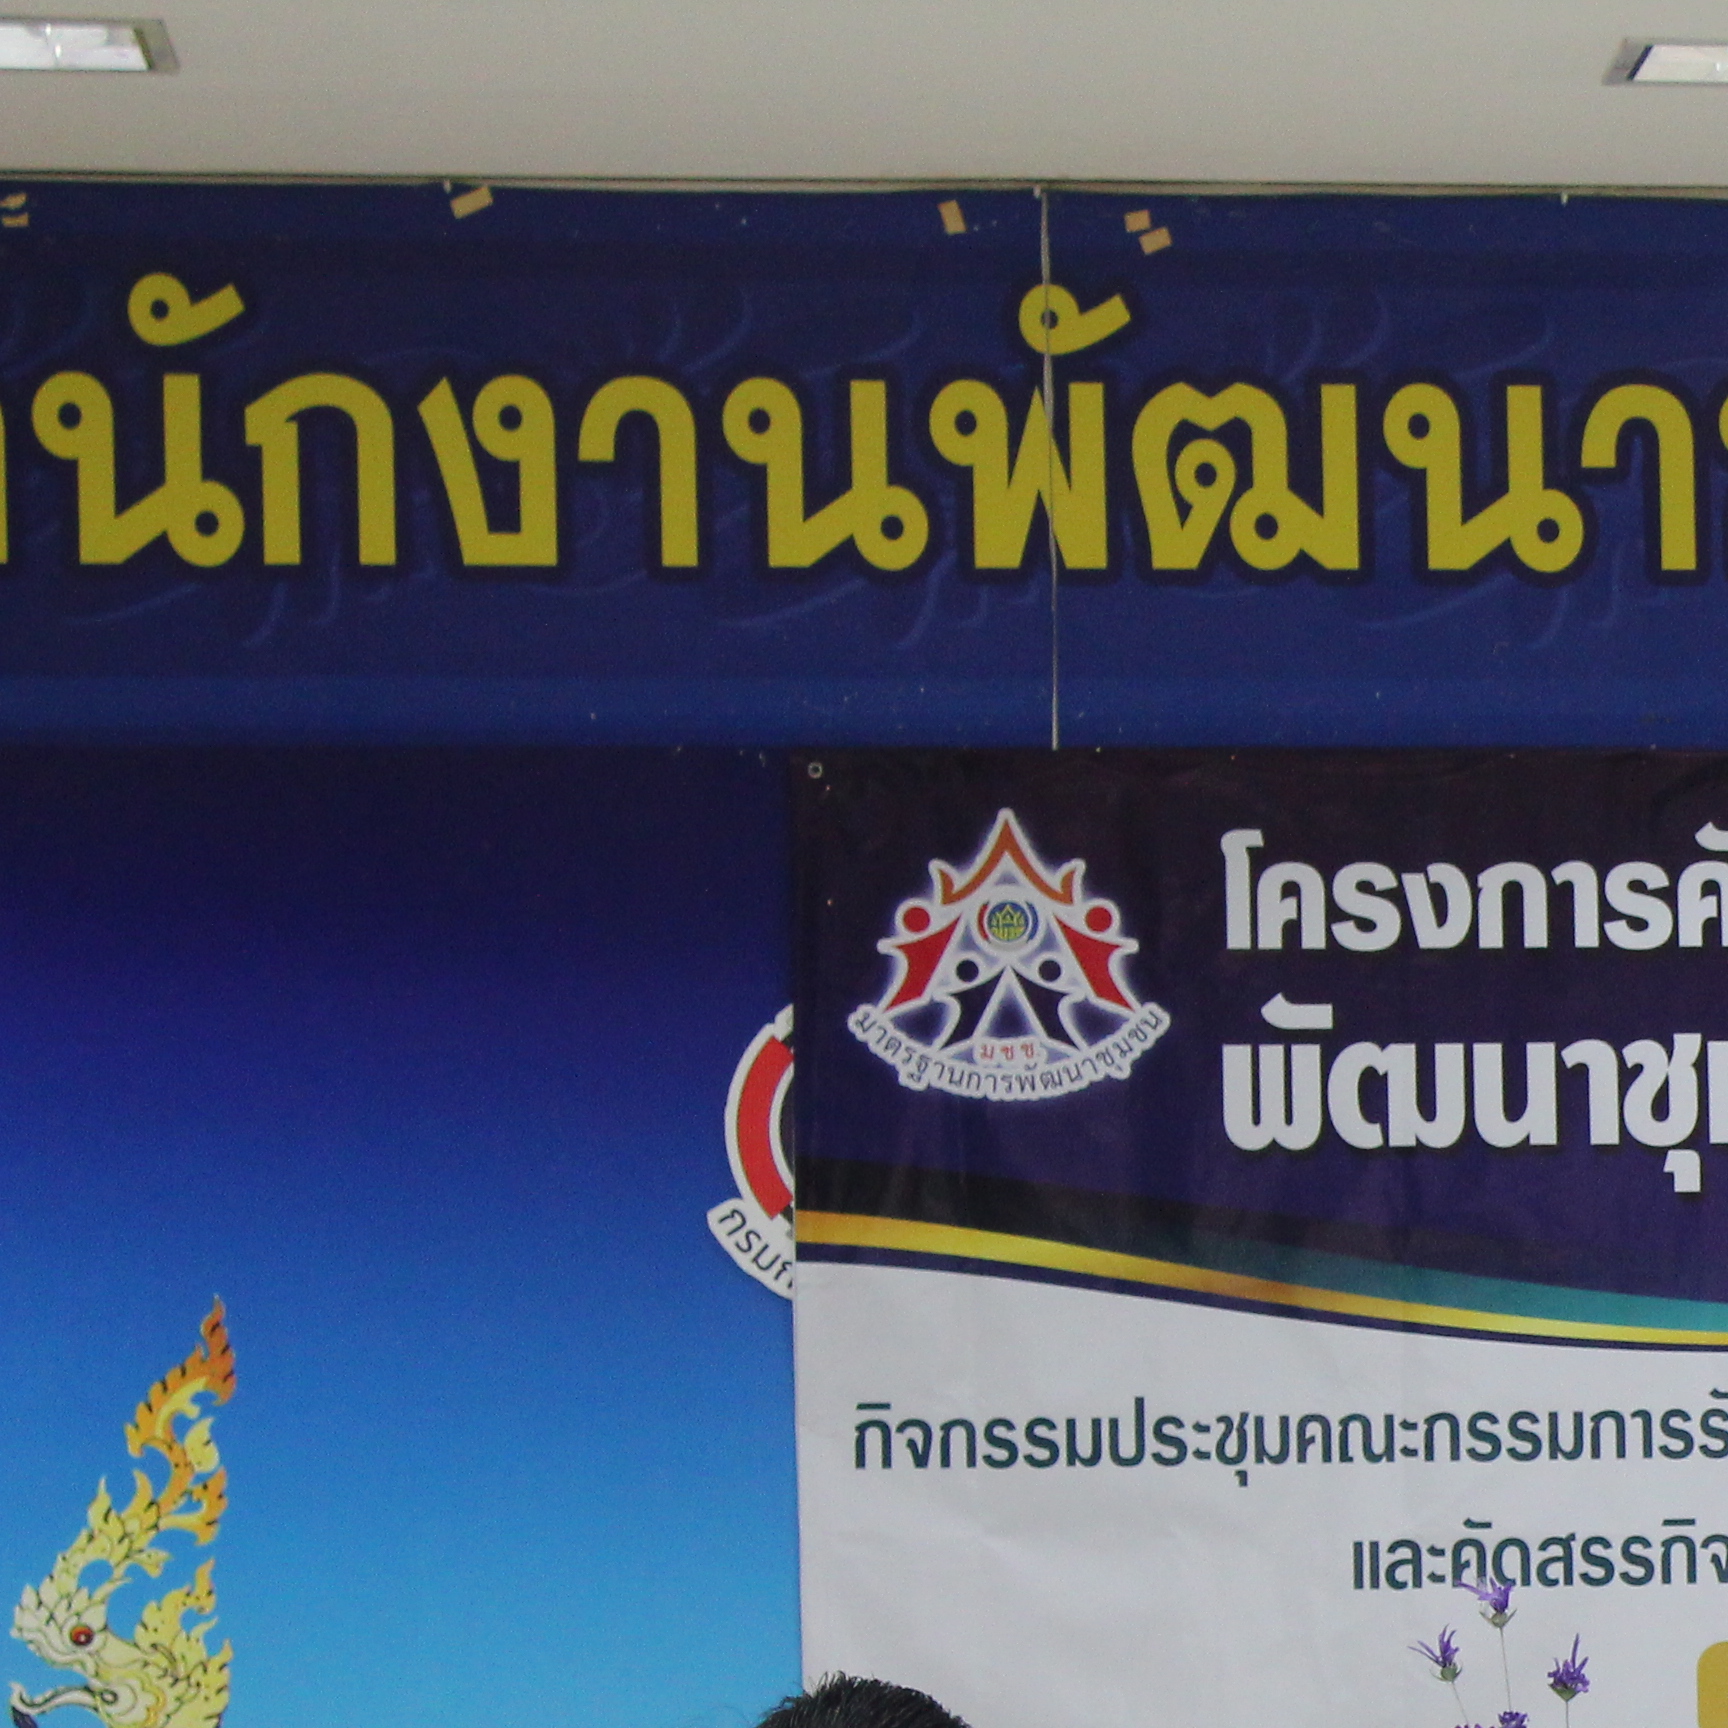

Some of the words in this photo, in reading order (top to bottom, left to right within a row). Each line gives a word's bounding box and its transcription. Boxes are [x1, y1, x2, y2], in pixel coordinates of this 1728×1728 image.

[856, 1008, 1163, 1094] มาตรฐานการพัฒนาชุมชน
